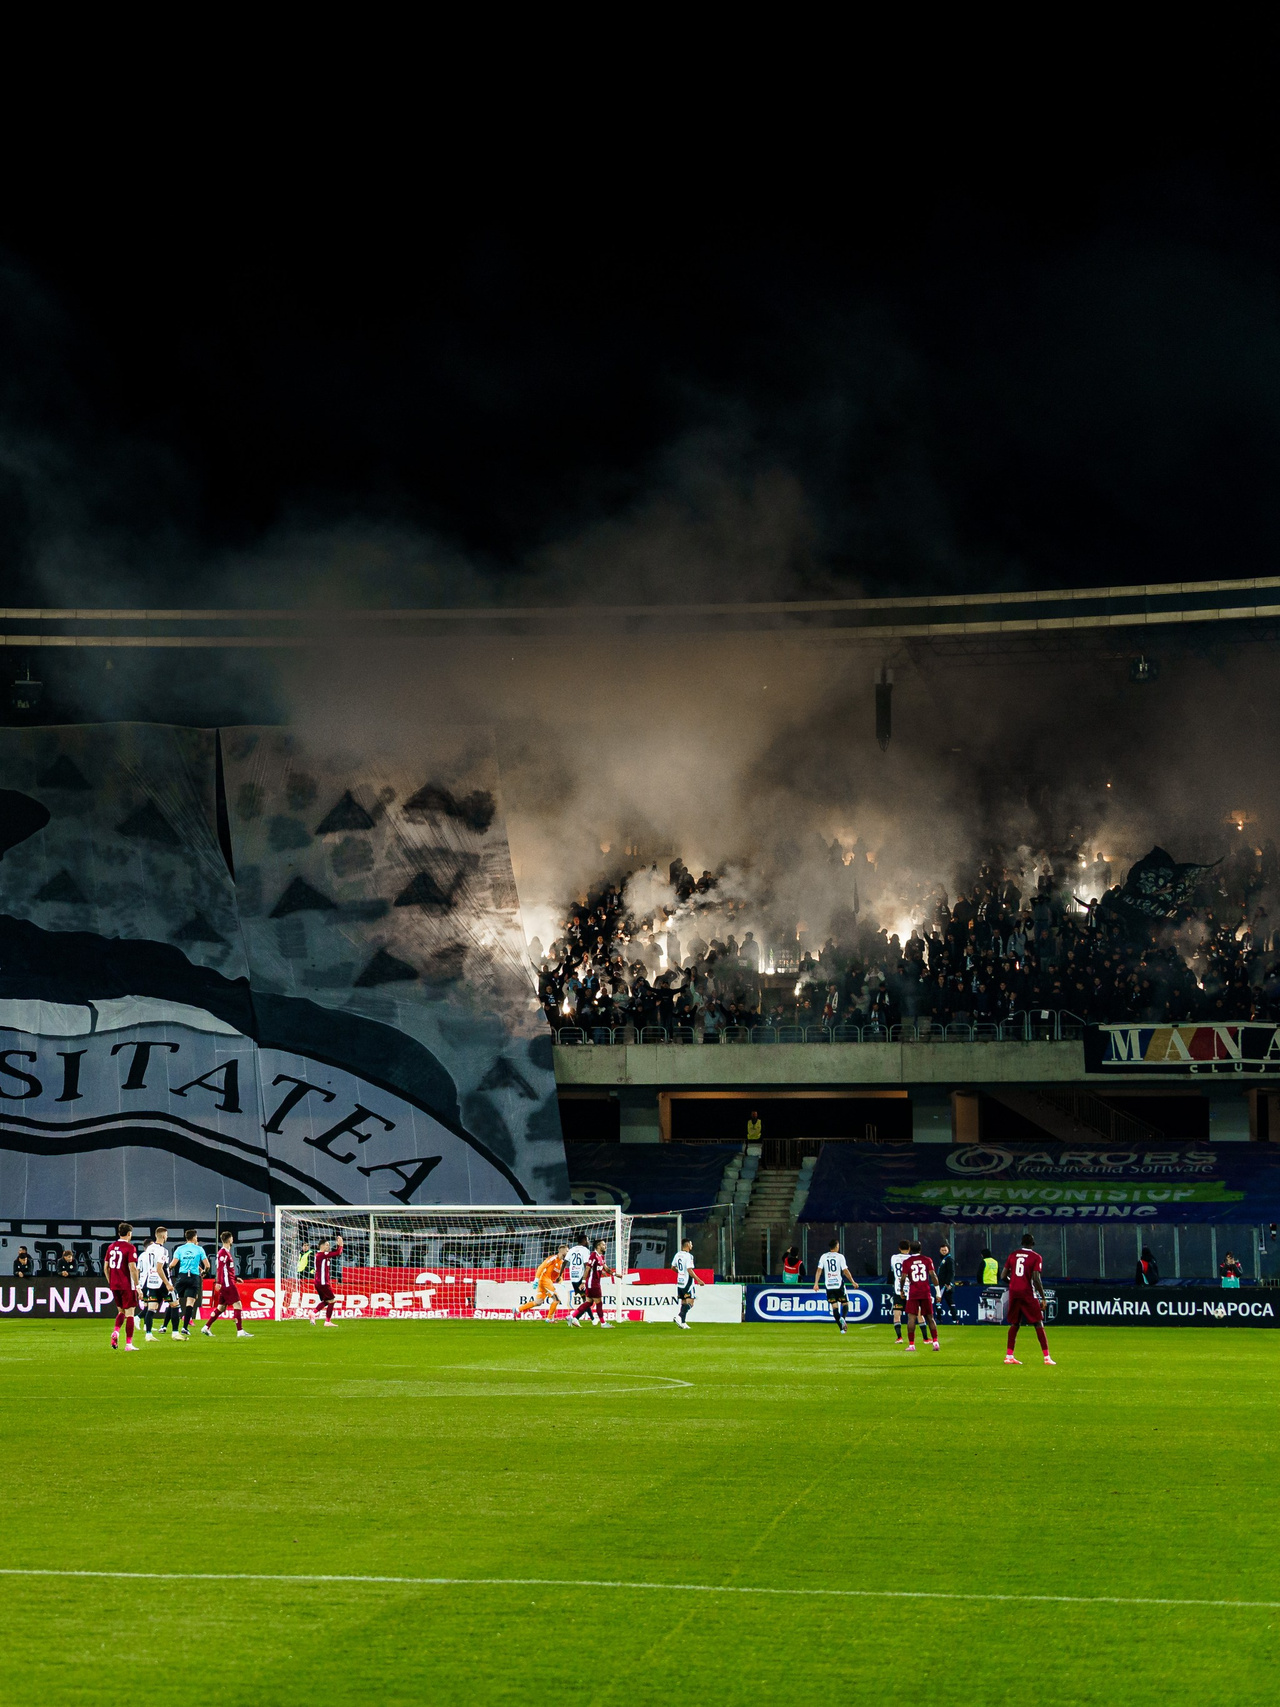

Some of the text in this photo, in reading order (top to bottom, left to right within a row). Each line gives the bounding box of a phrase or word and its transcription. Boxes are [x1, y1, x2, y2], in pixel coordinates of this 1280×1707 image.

[1017, 1151, 1217, 1166] AROBS
[939, 1205, 1158, 1217] SUPPORTING
[109, 1250, 123, 1269] 27
[571, 1252, 582, 1266] 26
[677, 1258, 683, 1272] 6
[826, 1258, 837, 1272] 18
[910, 1263, 927, 1282] 23
[1015, 1257, 1025, 1277] 6
[1068, 1297, 1151, 1315] PRIMĂRIA
[388, 1309, 449, 1319] SUPERBET
